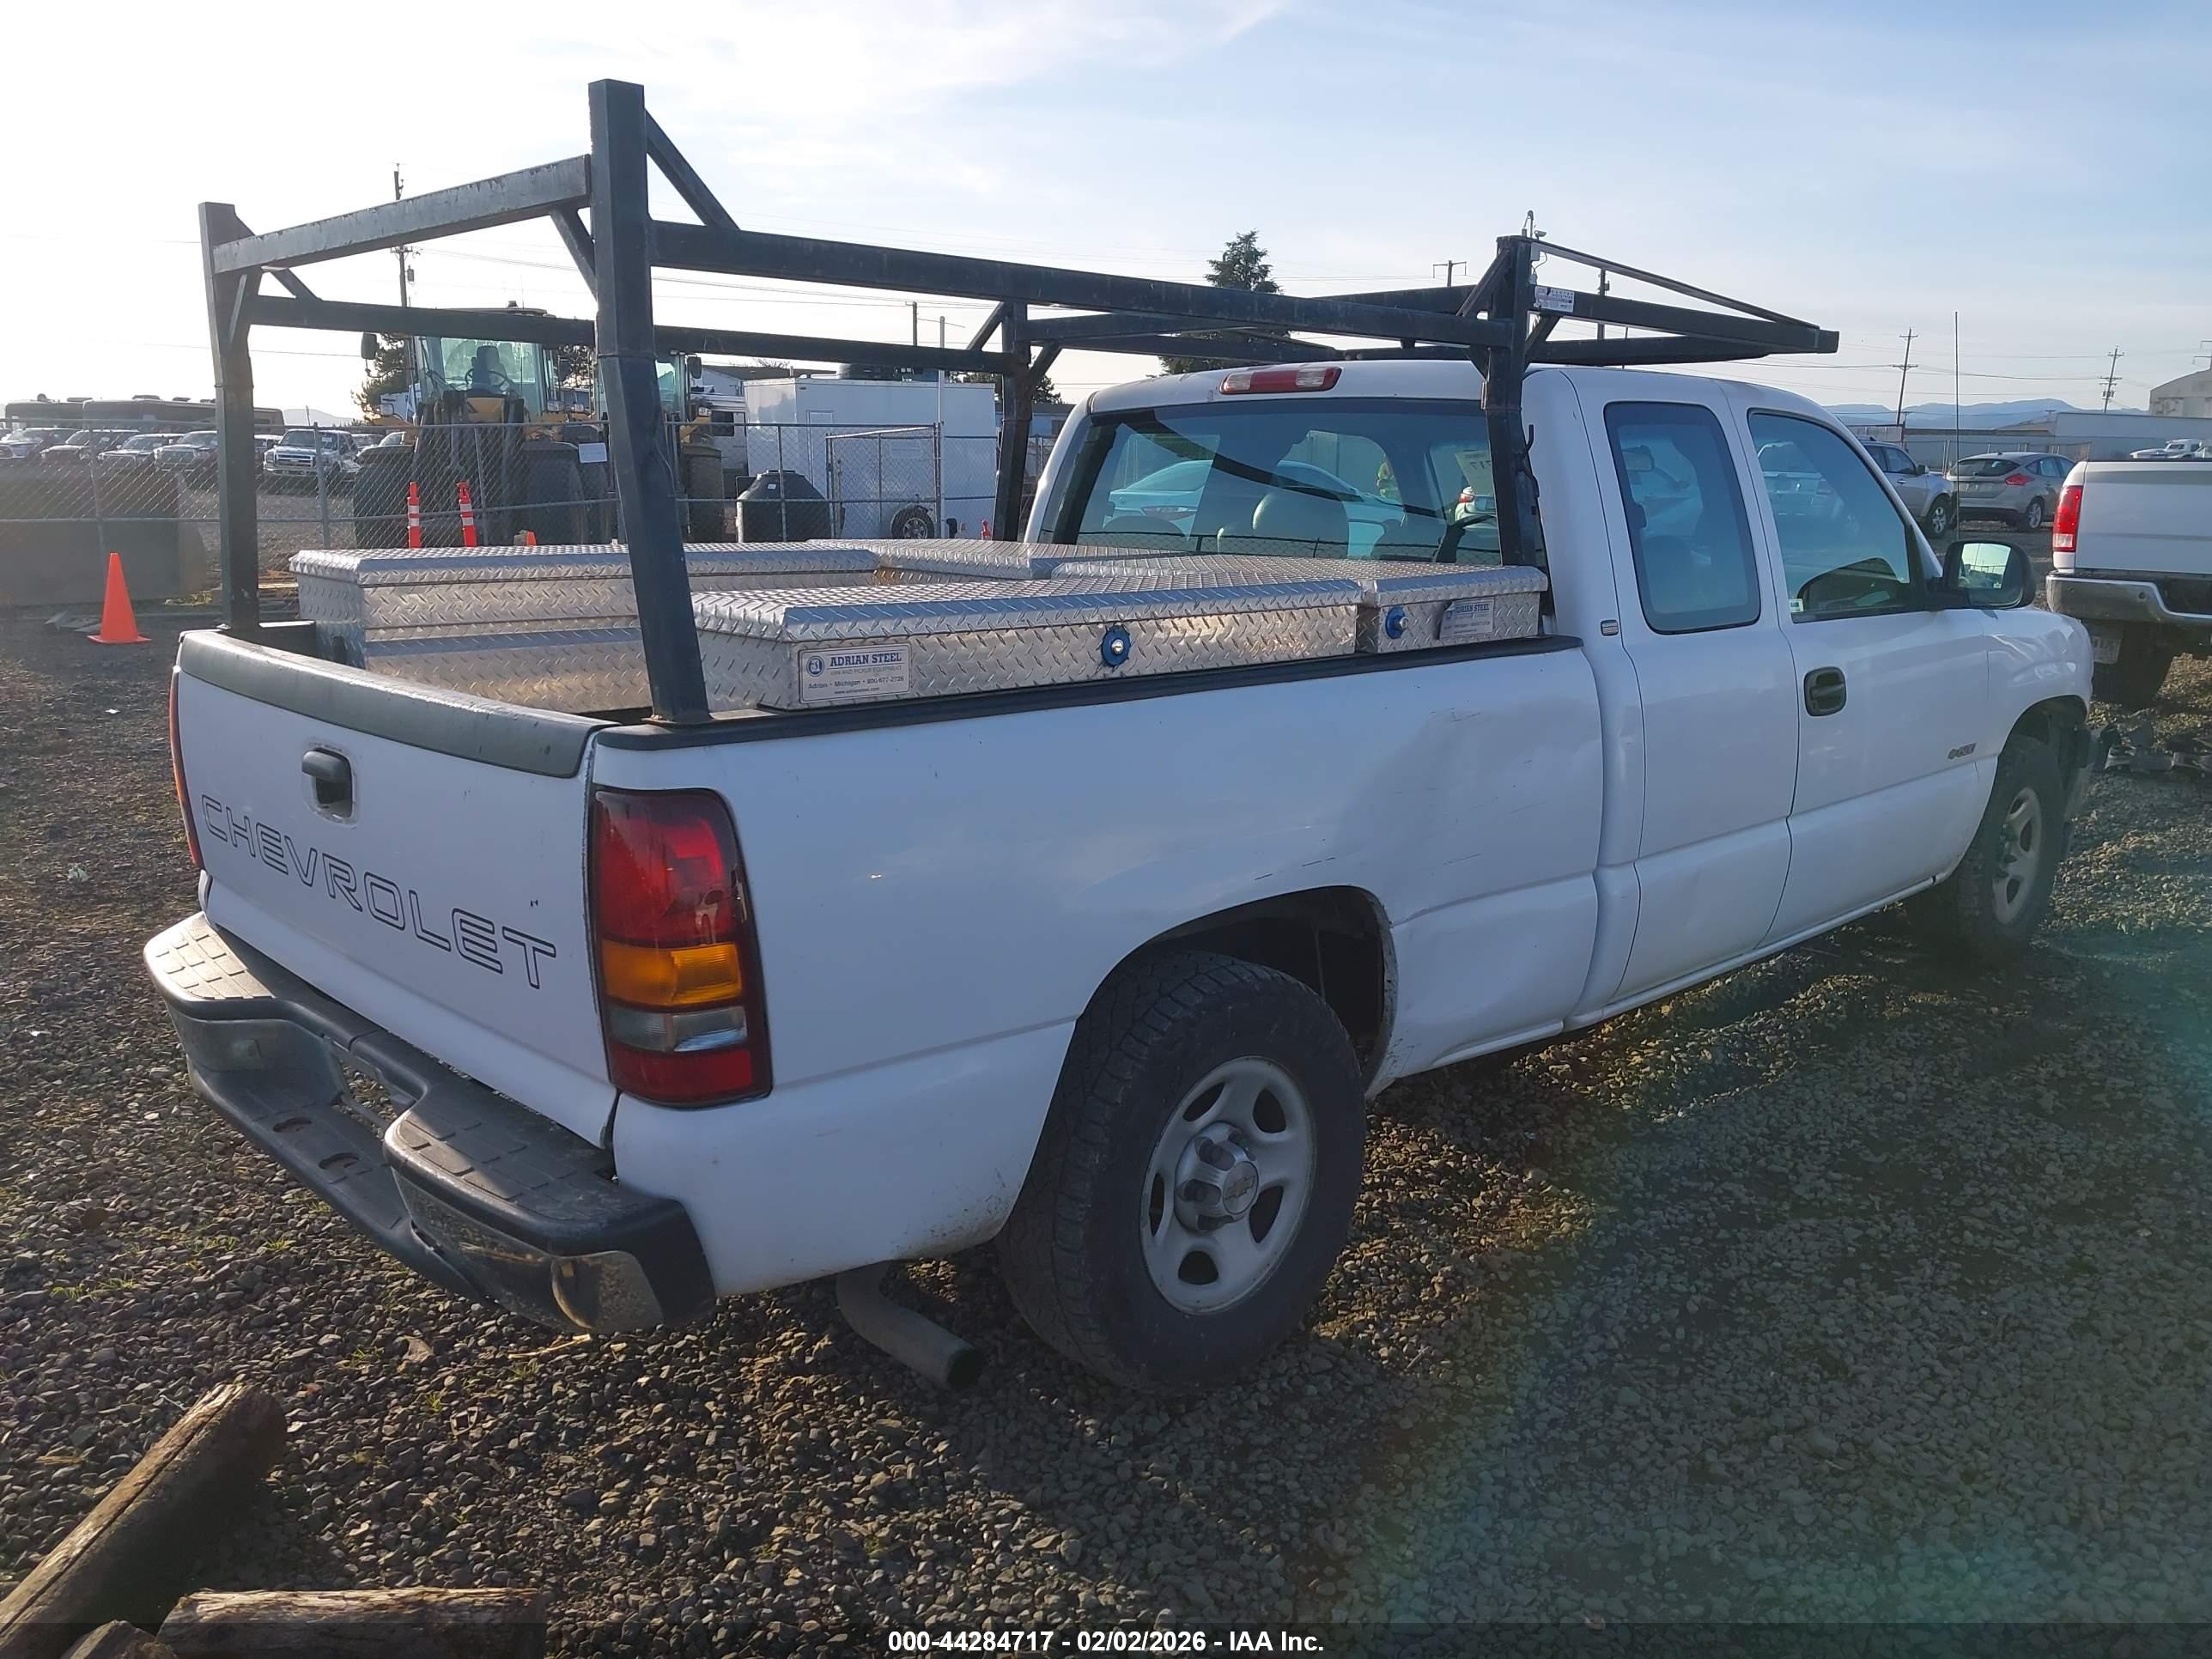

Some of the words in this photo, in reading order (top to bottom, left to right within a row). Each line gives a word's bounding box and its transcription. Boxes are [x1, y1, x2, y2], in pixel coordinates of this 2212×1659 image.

[830, 654, 869, 667] ADRIAN
[872, 653, 902, 664] STEEL
[201, 794, 556, 989] CHEVROLET
